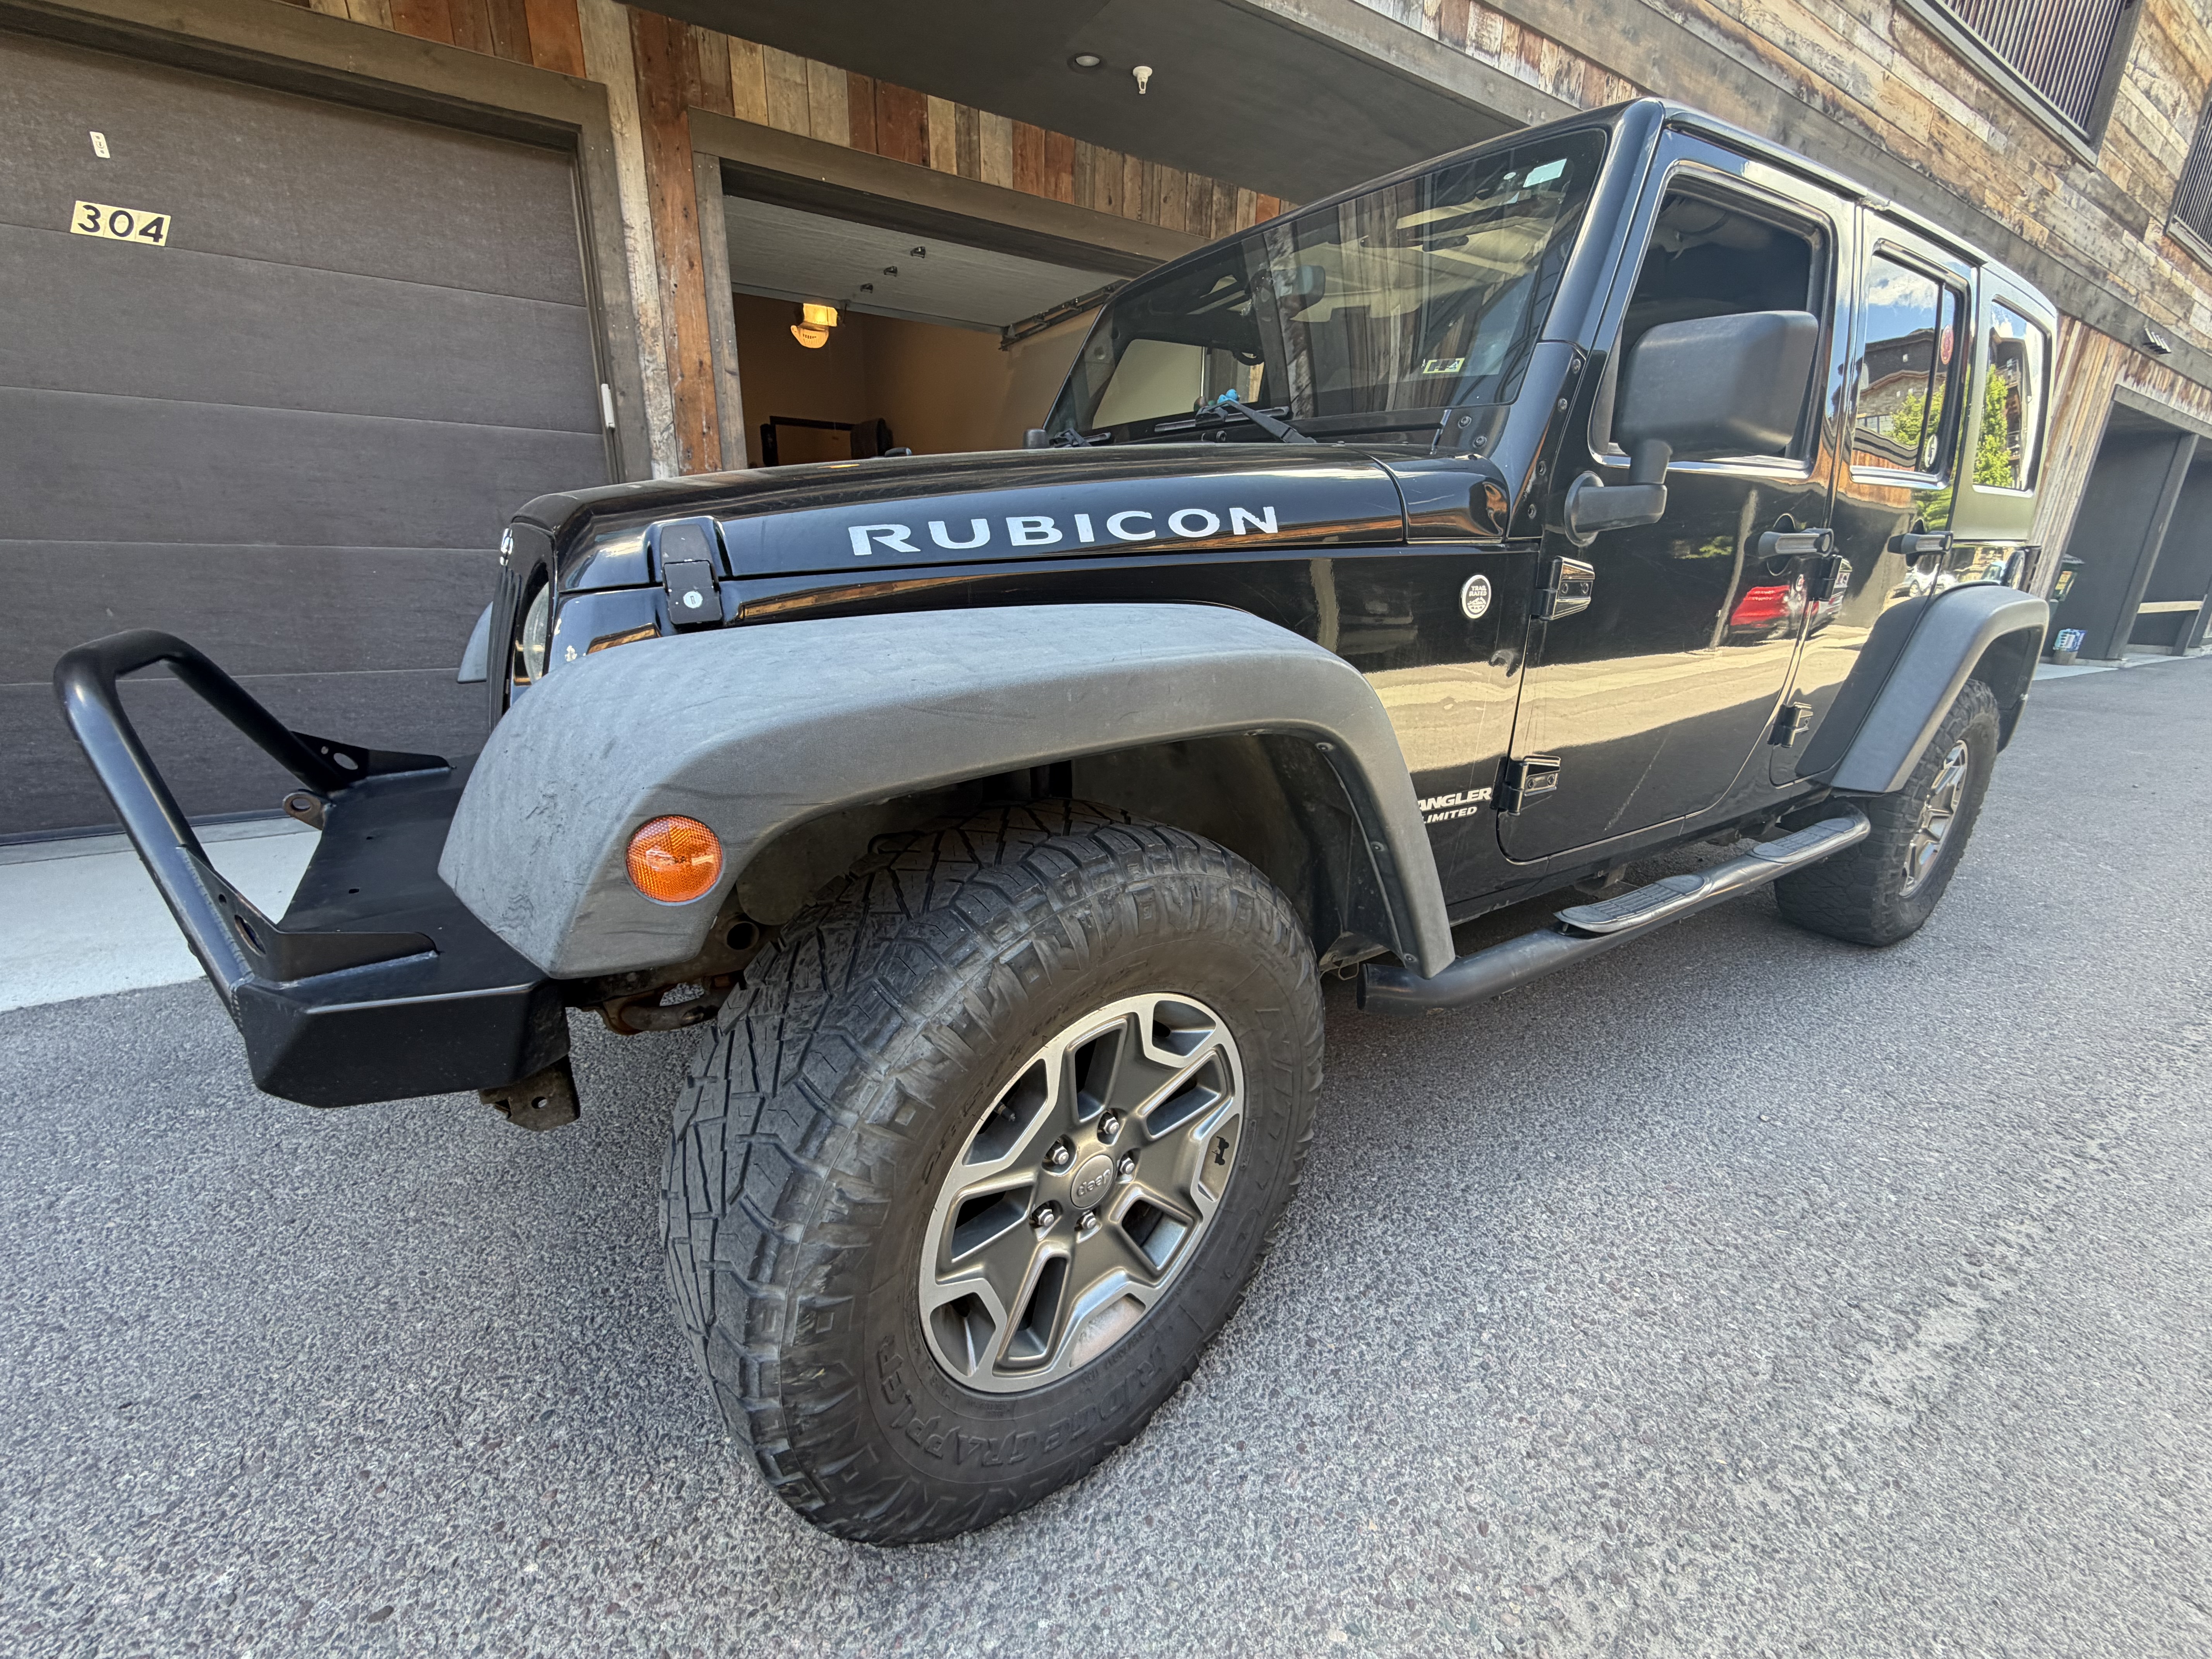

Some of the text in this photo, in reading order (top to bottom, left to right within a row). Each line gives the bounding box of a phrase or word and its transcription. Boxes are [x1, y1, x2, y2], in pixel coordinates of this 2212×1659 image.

[77, 204, 165, 243] 304
[848, 506, 1278, 556] RUBICON
[1417, 787, 1492, 811] ANGLER
[1077, 1169, 1111, 1196] Jeep
